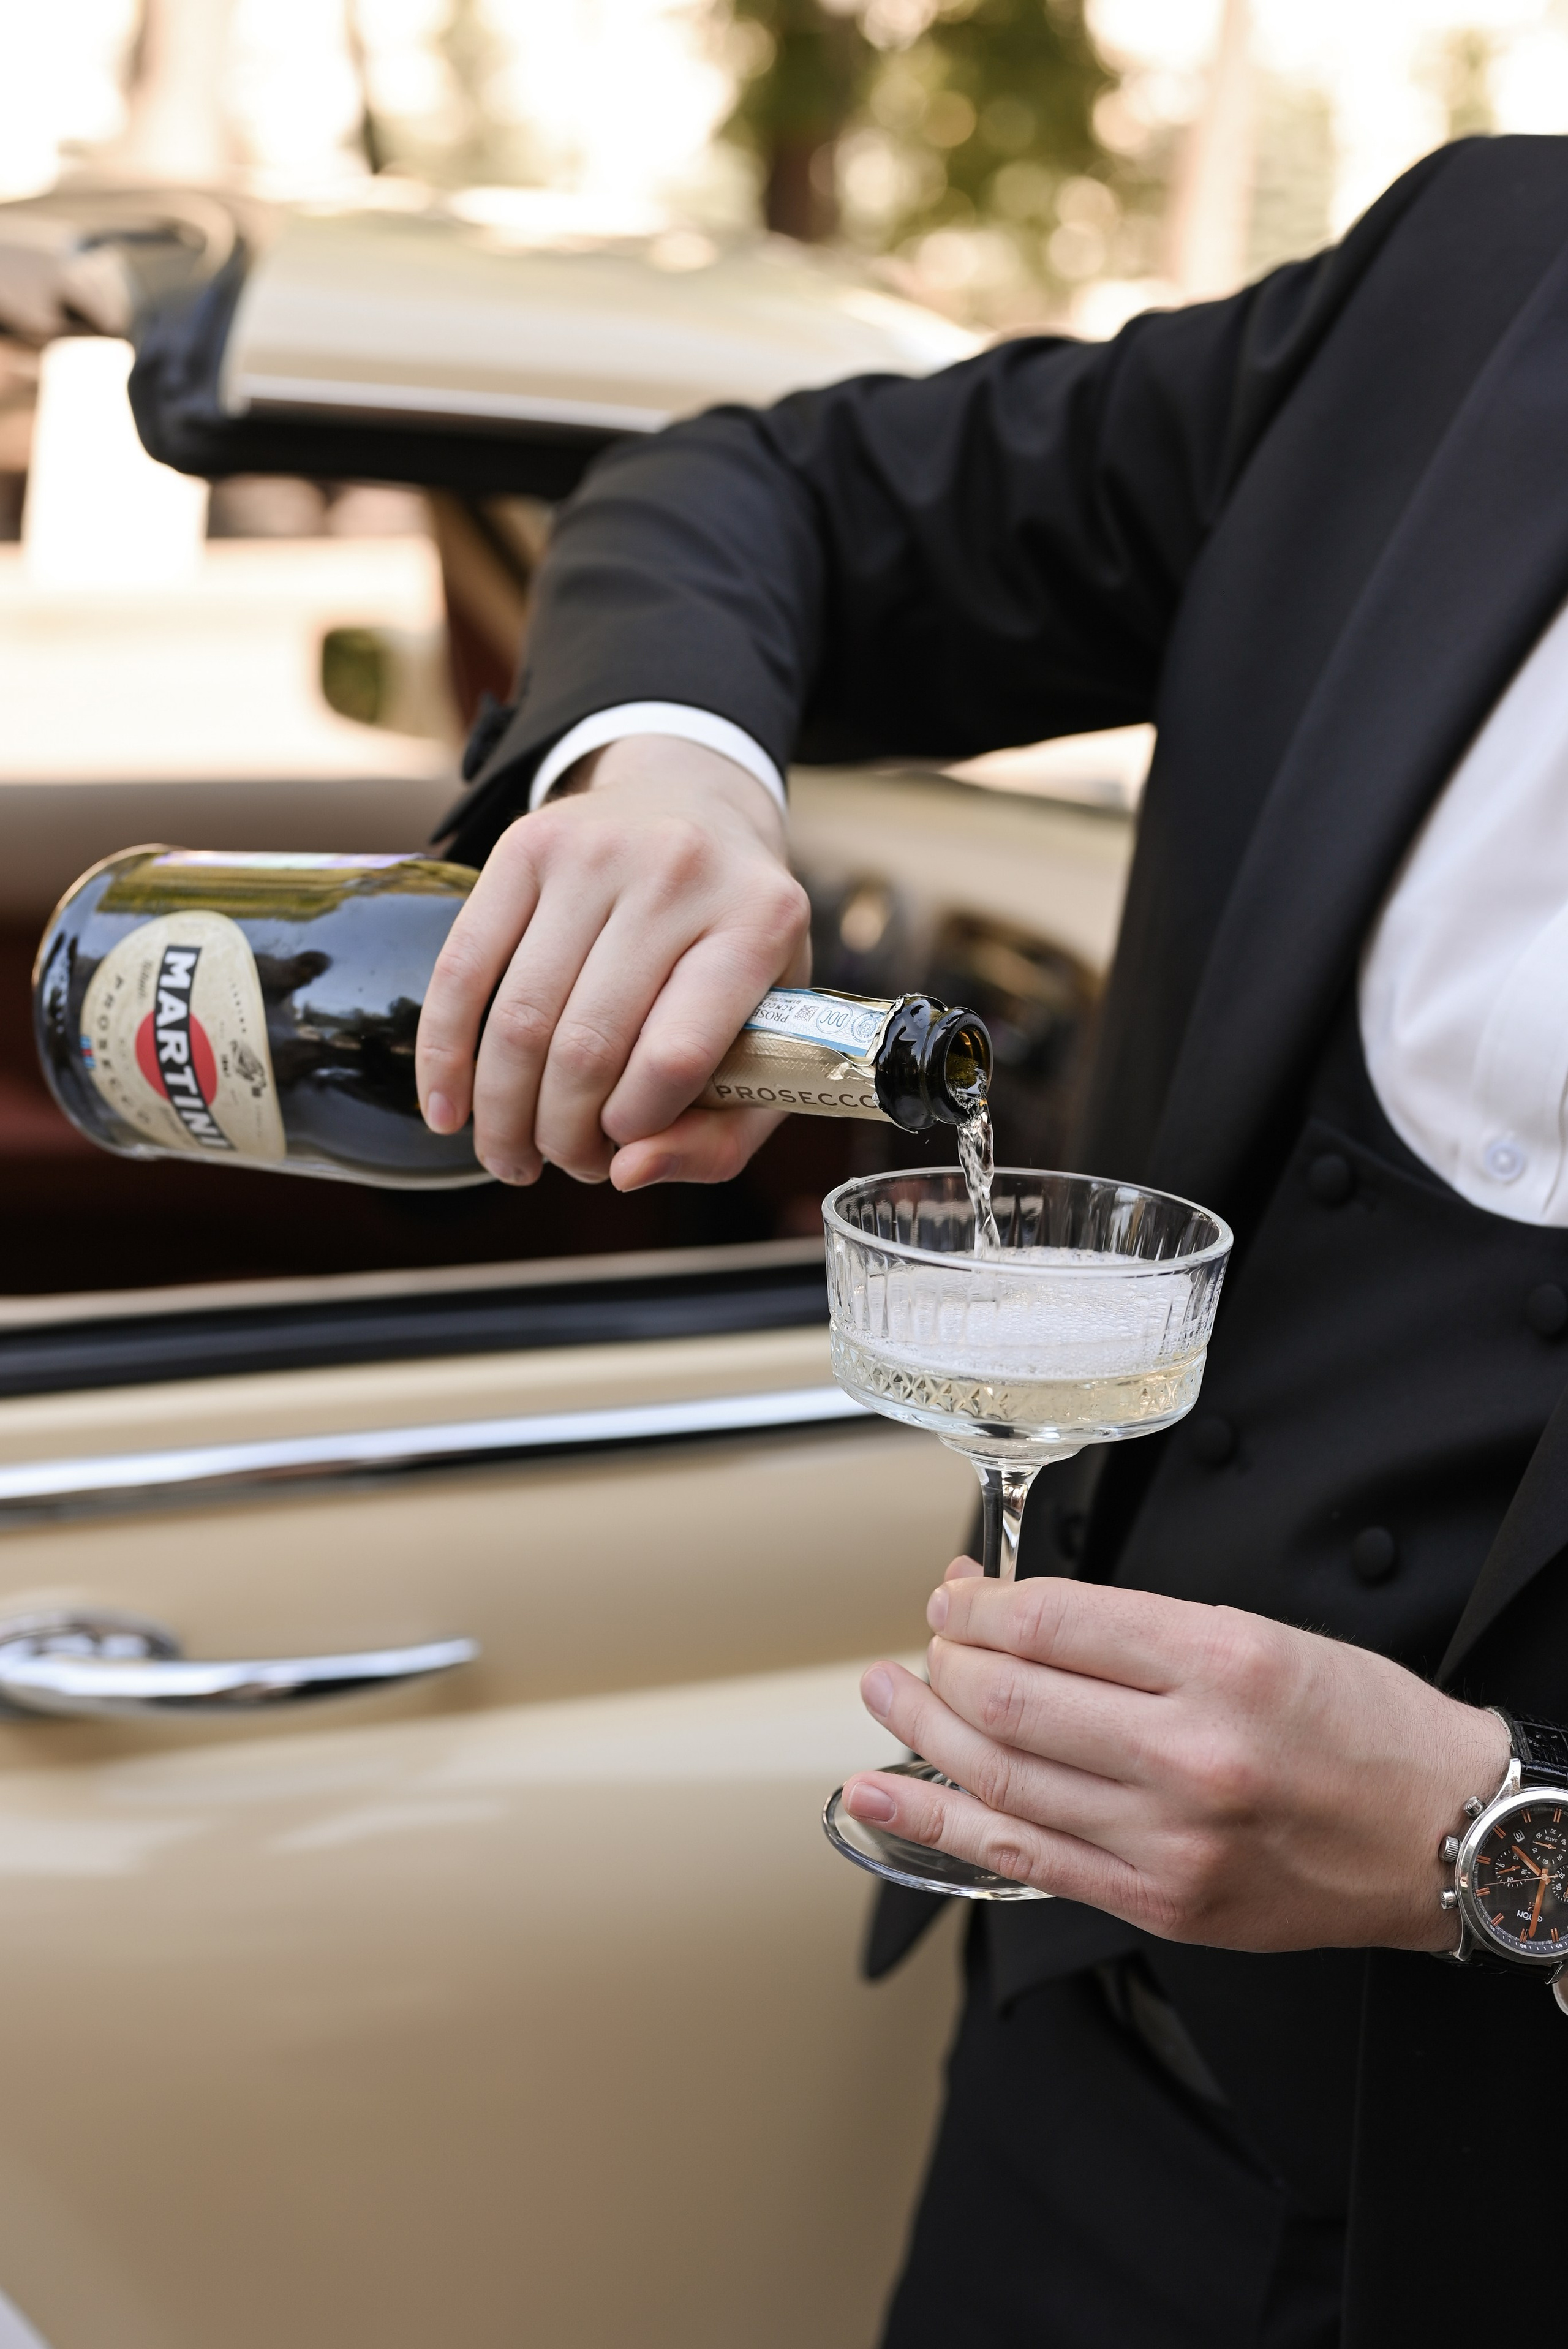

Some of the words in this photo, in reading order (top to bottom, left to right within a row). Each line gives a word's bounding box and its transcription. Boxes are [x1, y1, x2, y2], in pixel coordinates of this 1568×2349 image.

[752, 1008, 789, 1023] PROSE
[820, 1010, 849, 1027] DOC
[156, 951, 230, 1148] MARTINI
[716, 1085, 879, 1109] PROSECCO
[1517, 1910, 1543, 1923] GYON
